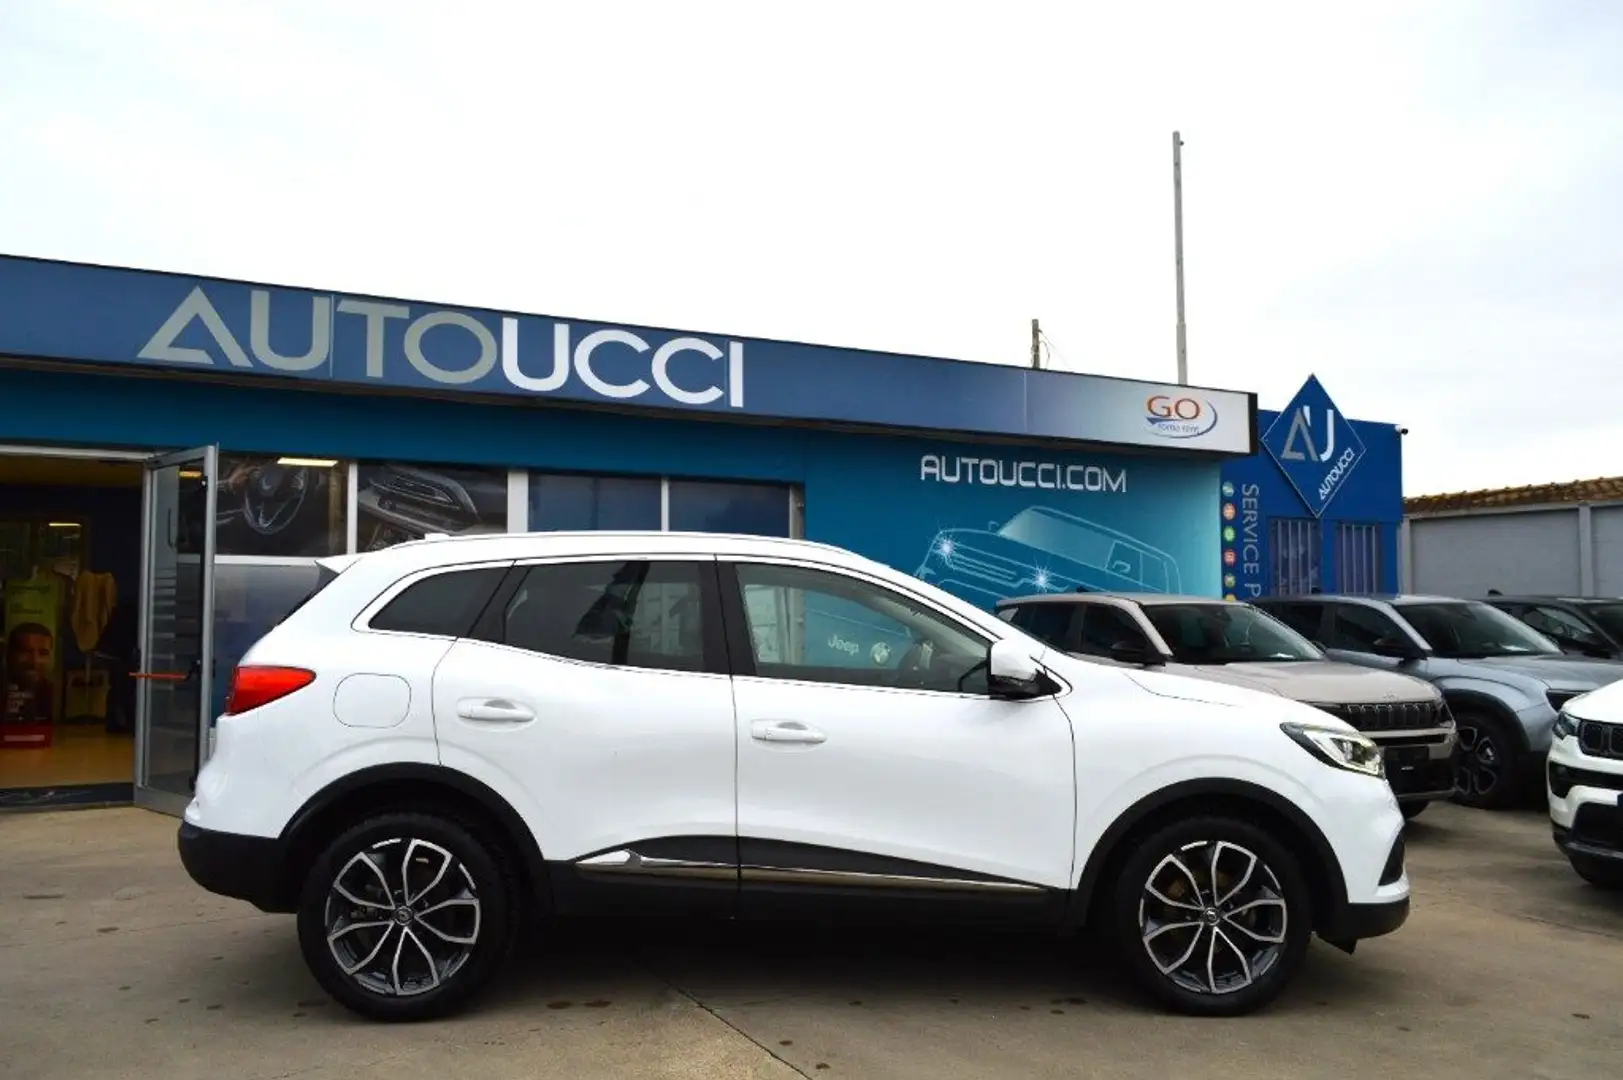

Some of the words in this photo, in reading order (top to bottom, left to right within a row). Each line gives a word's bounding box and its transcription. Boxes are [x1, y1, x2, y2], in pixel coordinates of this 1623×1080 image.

[136, 285, 743, 408] AUTOUCCI
[1147, 395, 1200, 419] GO
[920, 454, 1127, 493] AUTOUCCI.COM
[1318, 447, 1355, 500] AUTOUCCI
[1241, 483, 1260, 575] SERVICE
[827, 634, 859, 656] Jeep
